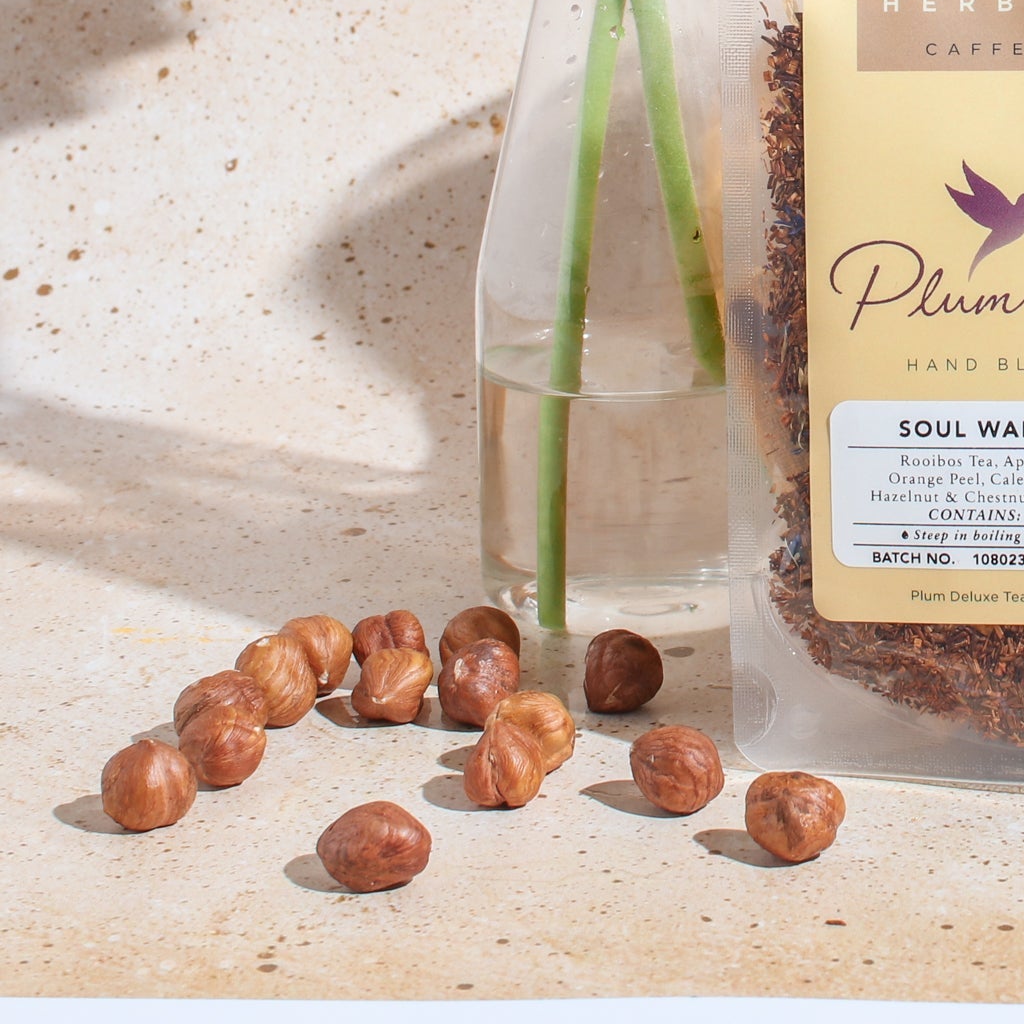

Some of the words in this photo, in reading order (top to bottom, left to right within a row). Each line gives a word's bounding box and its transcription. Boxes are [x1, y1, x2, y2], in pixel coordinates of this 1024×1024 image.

[908, 358, 977, 371] HAND
[898, 420, 967, 438] SOUL
[900, 454, 963, 467] Rooibos
[968, 455, 999, 468] Tea,
[888, 472, 944, 488] Orange
[949, 473, 985, 486] Peel,
[870, 490, 939, 502] Hazelnut
[945, 492, 959, 503] &
[928, 509, 1021, 521] CONTAINS:
[913, 530, 949, 544] Steep
[953, 530, 968, 540] in
[972, 530, 1022, 544] boiling
[872, 552, 922, 564] BATCH
[926, 553, 956, 565] NO.
[911, 590, 946, 601] Plum
[950, 591, 999, 602] Deluxe
